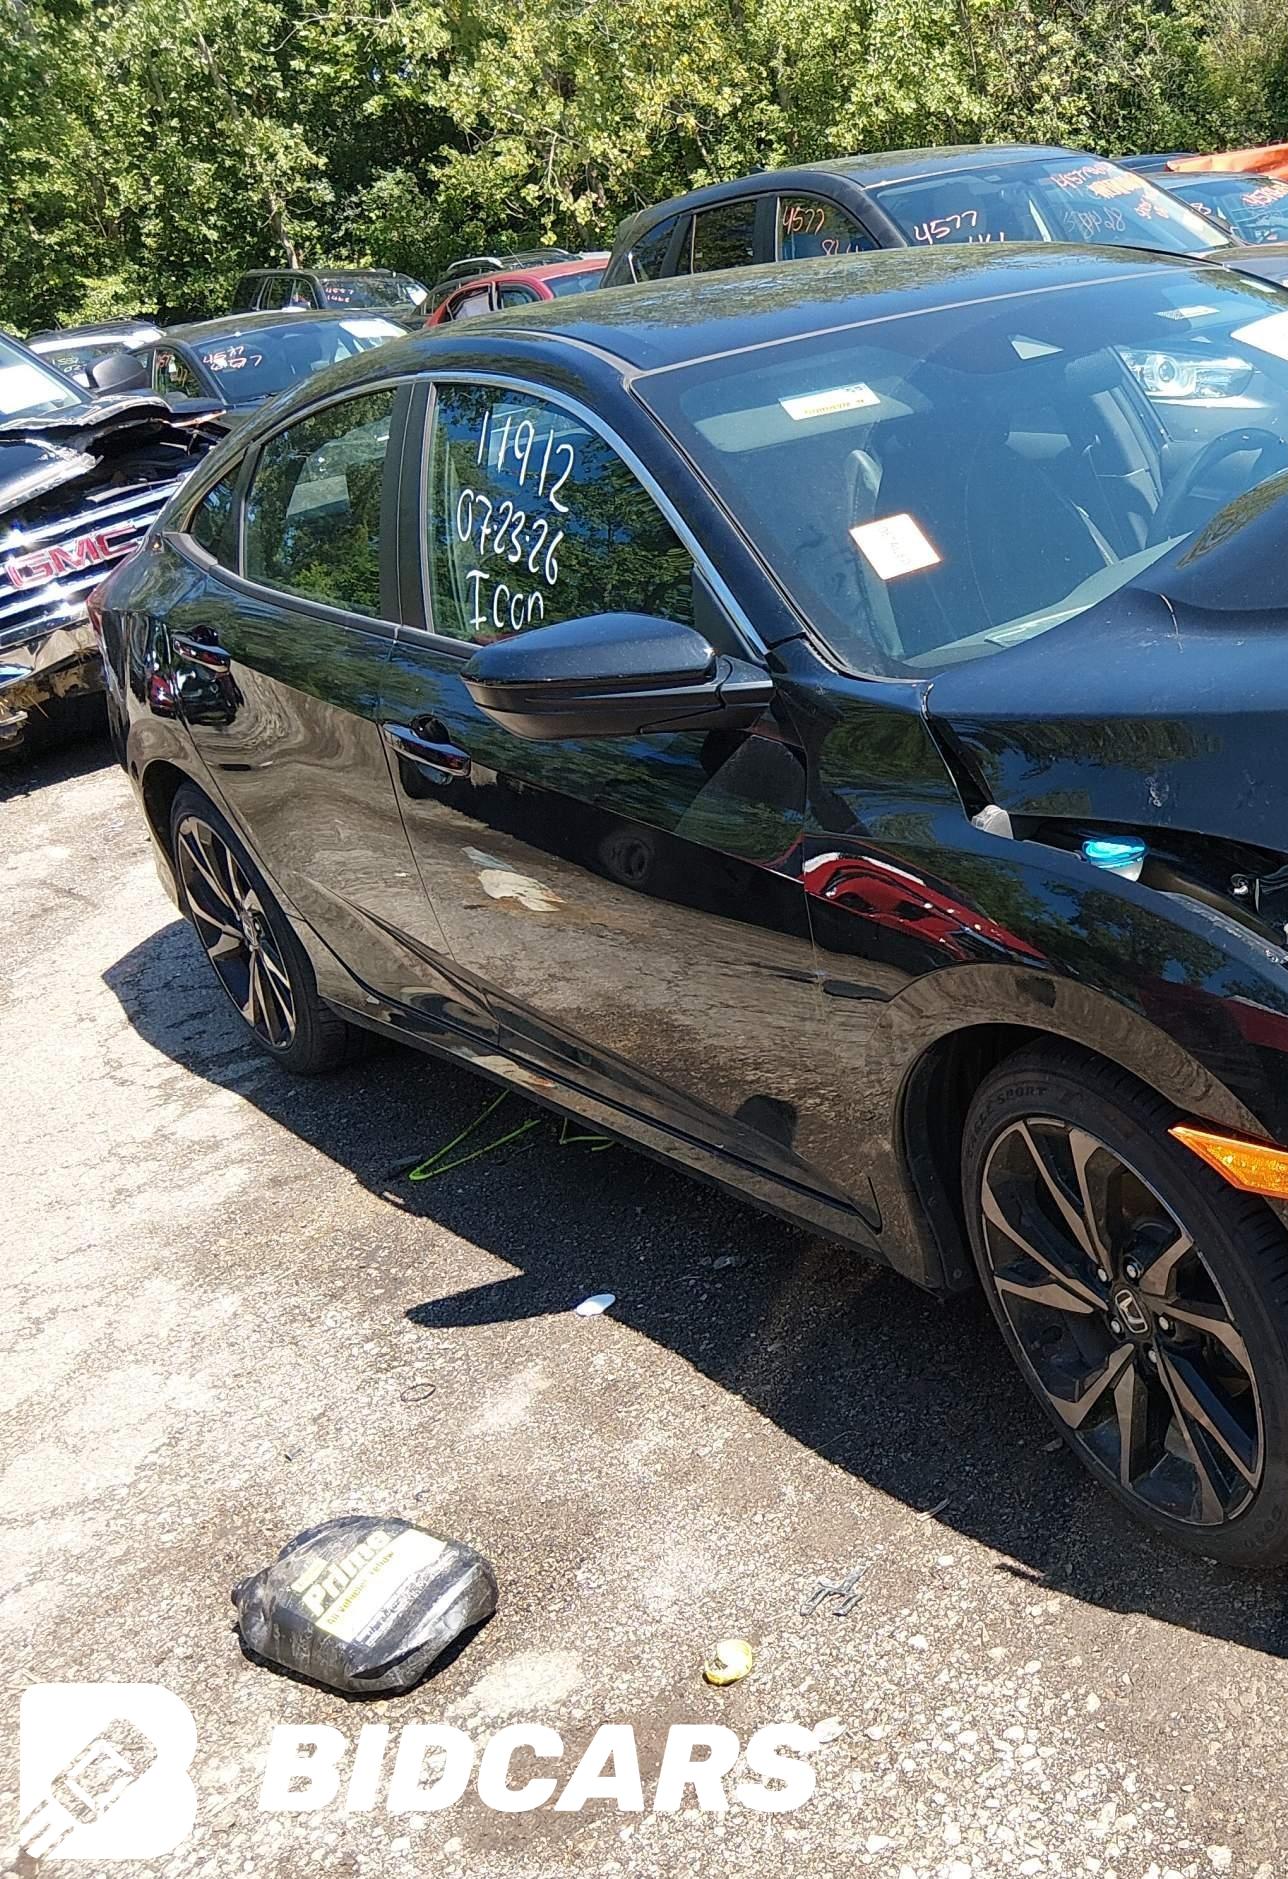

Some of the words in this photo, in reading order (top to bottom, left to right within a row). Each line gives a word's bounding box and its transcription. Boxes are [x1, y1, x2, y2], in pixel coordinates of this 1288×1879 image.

[782, 205, 825, 236] 4577
[913, 210, 977, 245] 4577
[5, 524, 140, 590] GMC
[997, 1086, 1048, 1105] SPORT
[301, 1530, 393, 1618] Prime
